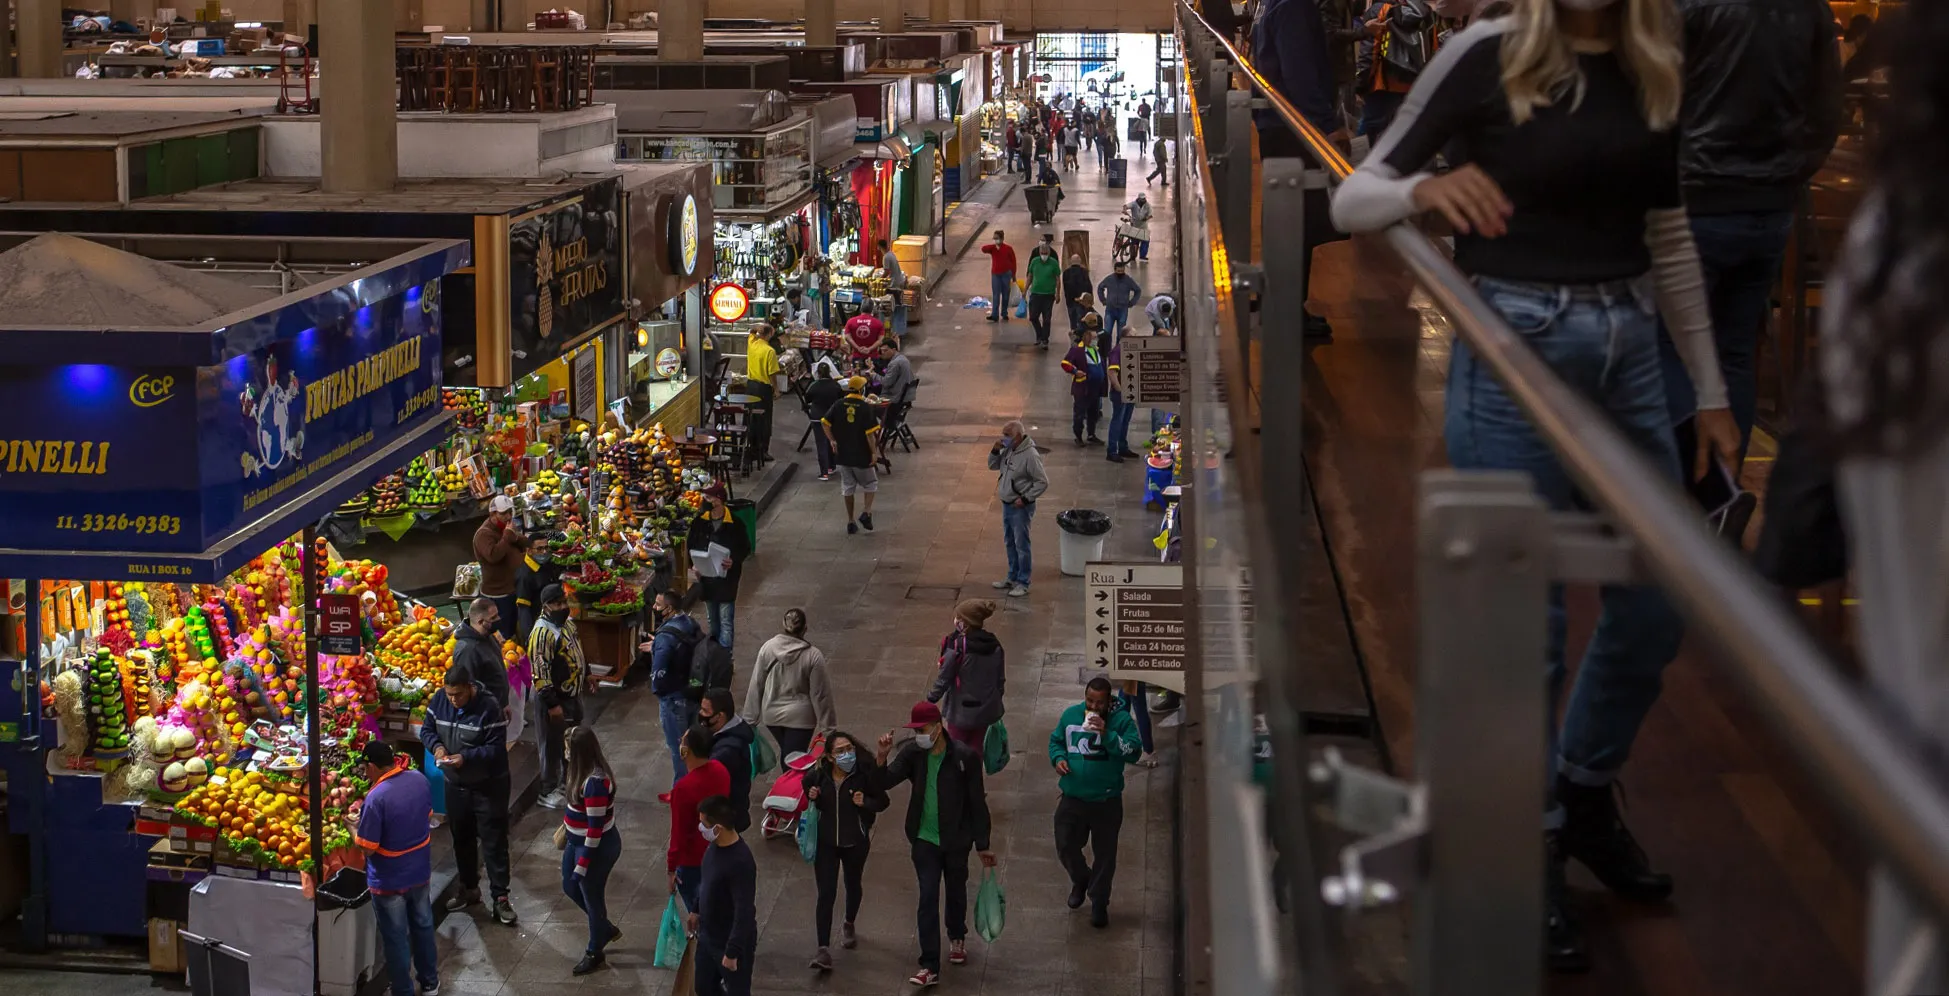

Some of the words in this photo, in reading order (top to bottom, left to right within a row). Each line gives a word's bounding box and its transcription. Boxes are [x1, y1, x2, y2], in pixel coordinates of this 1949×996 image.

[561, 259, 607, 306] FRUTAS
[715, 299, 742, 308] GERMANIA
[305, 365, 355, 423] FRUTAS
[356, 335, 421, 398] PARPINELLI
[138, 375, 174, 399] FCP
[81, 513, 181, 535] 3326-9383
[128, 564, 149, 574] RUA
[158, 565, 179, 574] BOX
[181, 566, 192, 574] 16
[1091, 571, 1115, 583] Rua
[1123, 569, 1134, 584] J
[1123, 591, 1152, 601] Salada
[1123, 608, 1150, 617] Frutas
[329, 621, 352, 633] SP
[1123, 624, 1140, 633] Rua
[1142, 624, 1152, 633] 25
[1154, 624, 1165, 633] de
[1166, 624, 1184, 634] Mar
[1123, 641, 1147, 651] Caixa
[1149, 642, 1159, 651] 24
[1161, 642, 1185, 652] horas
[1123, 658, 1136, 667] Av.
[1138, 658, 1150, 668] do
[1151, 658, 1181, 668] Estado
